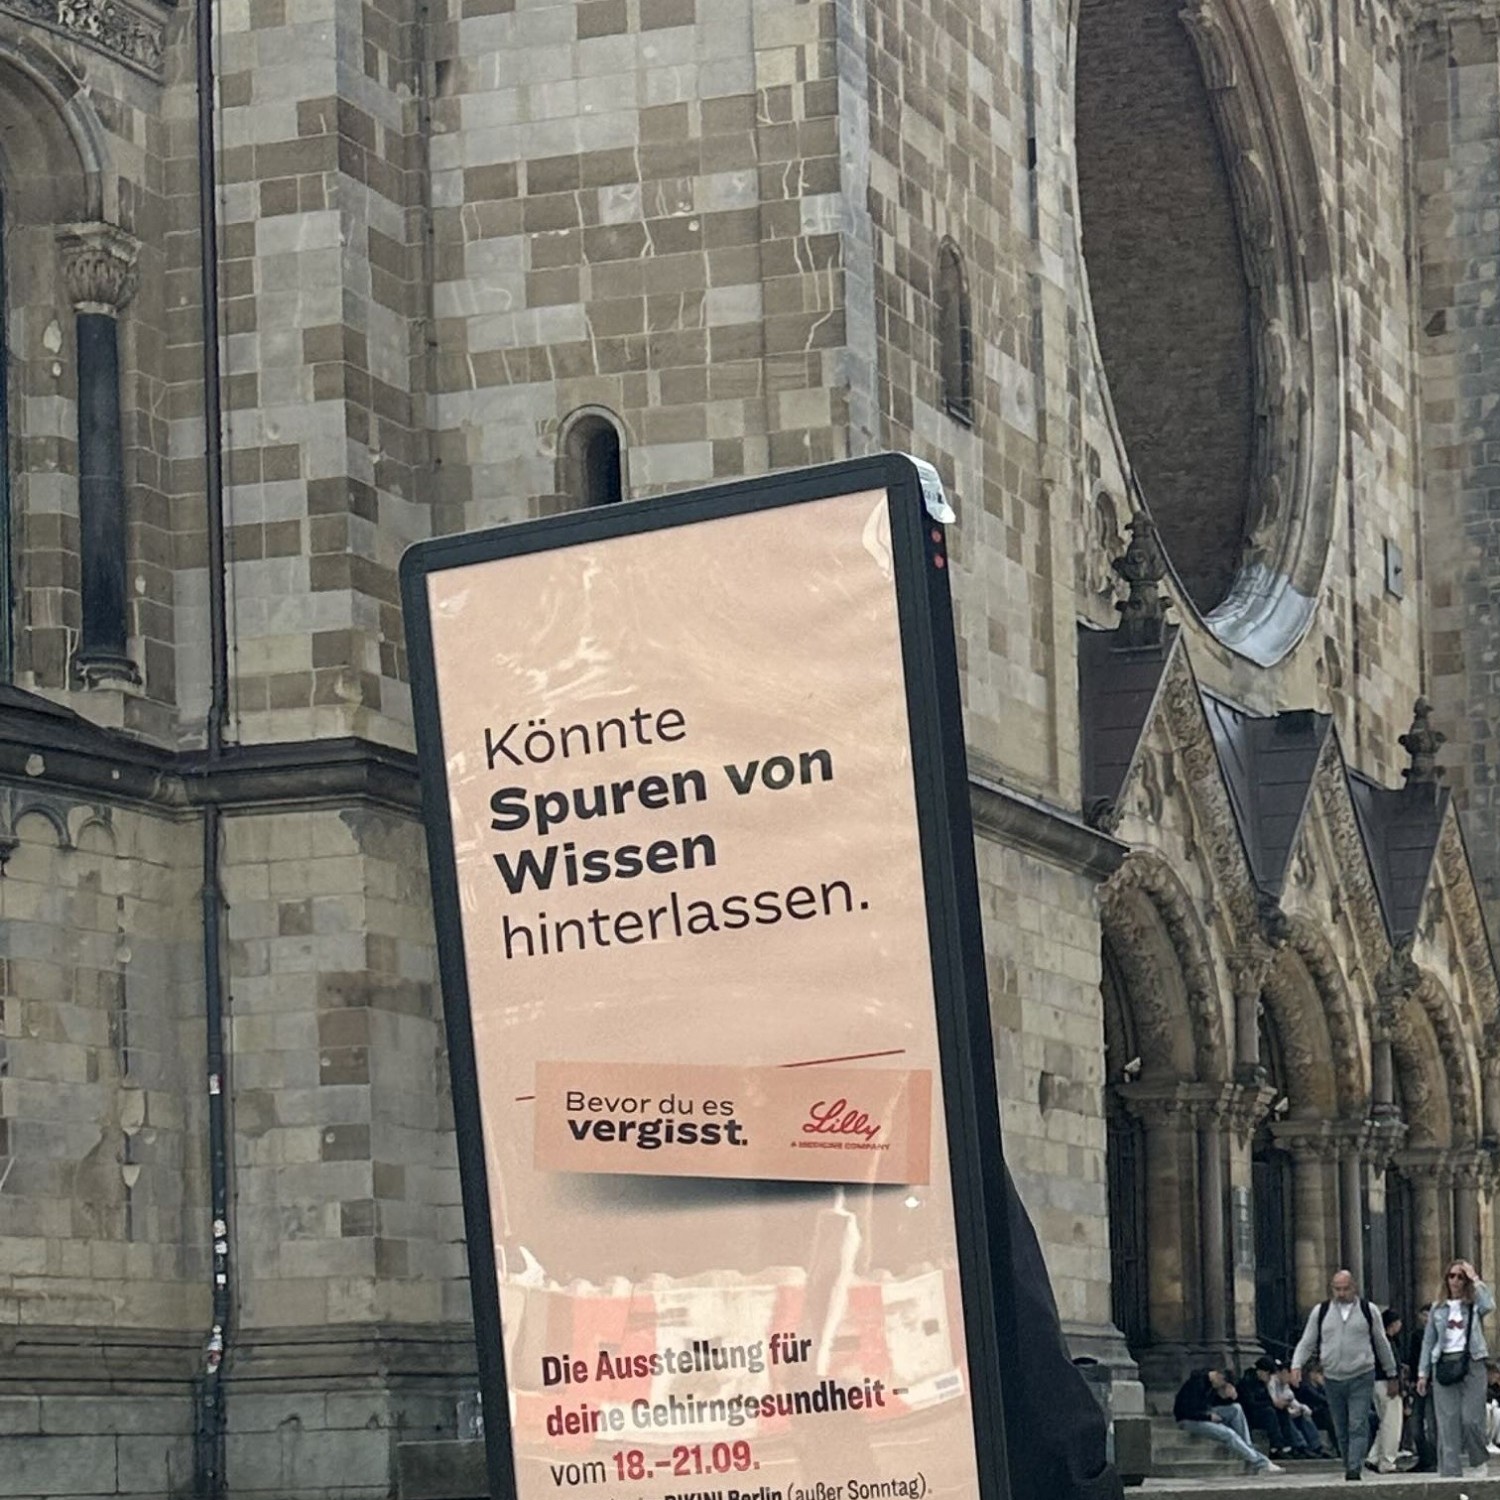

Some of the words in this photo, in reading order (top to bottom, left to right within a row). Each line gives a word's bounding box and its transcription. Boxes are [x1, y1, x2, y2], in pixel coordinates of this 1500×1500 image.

[483, 706, 687, 770] Könnte
[490, 768, 708, 835] Spuren
[723, 747, 834, 795] von
[494, 832, 717, 895] Wissen
[502, 879, 870, 959] hinterlassen.
[566, 1091, 651, 1114] Bevor
[658, 1093, 695, 1116] du
[701, 1098, 734, 1116] es
[802, 1098, 881, 1141] Lilly
[567, 1117, 748, 1149] vergisst.
[541, 1353, 588, 1387] Die
[595, 1339, 765, 1382] Ausstellung
[769, 1332, 812, 1365] für
[546, 1403, 625, 1437] deine
[631, 1377, 886, 1429] Gehirngesundheit
[550, 1460, 607, 1487] vom
[847, 1471, 933, 1500] Sonntag).
